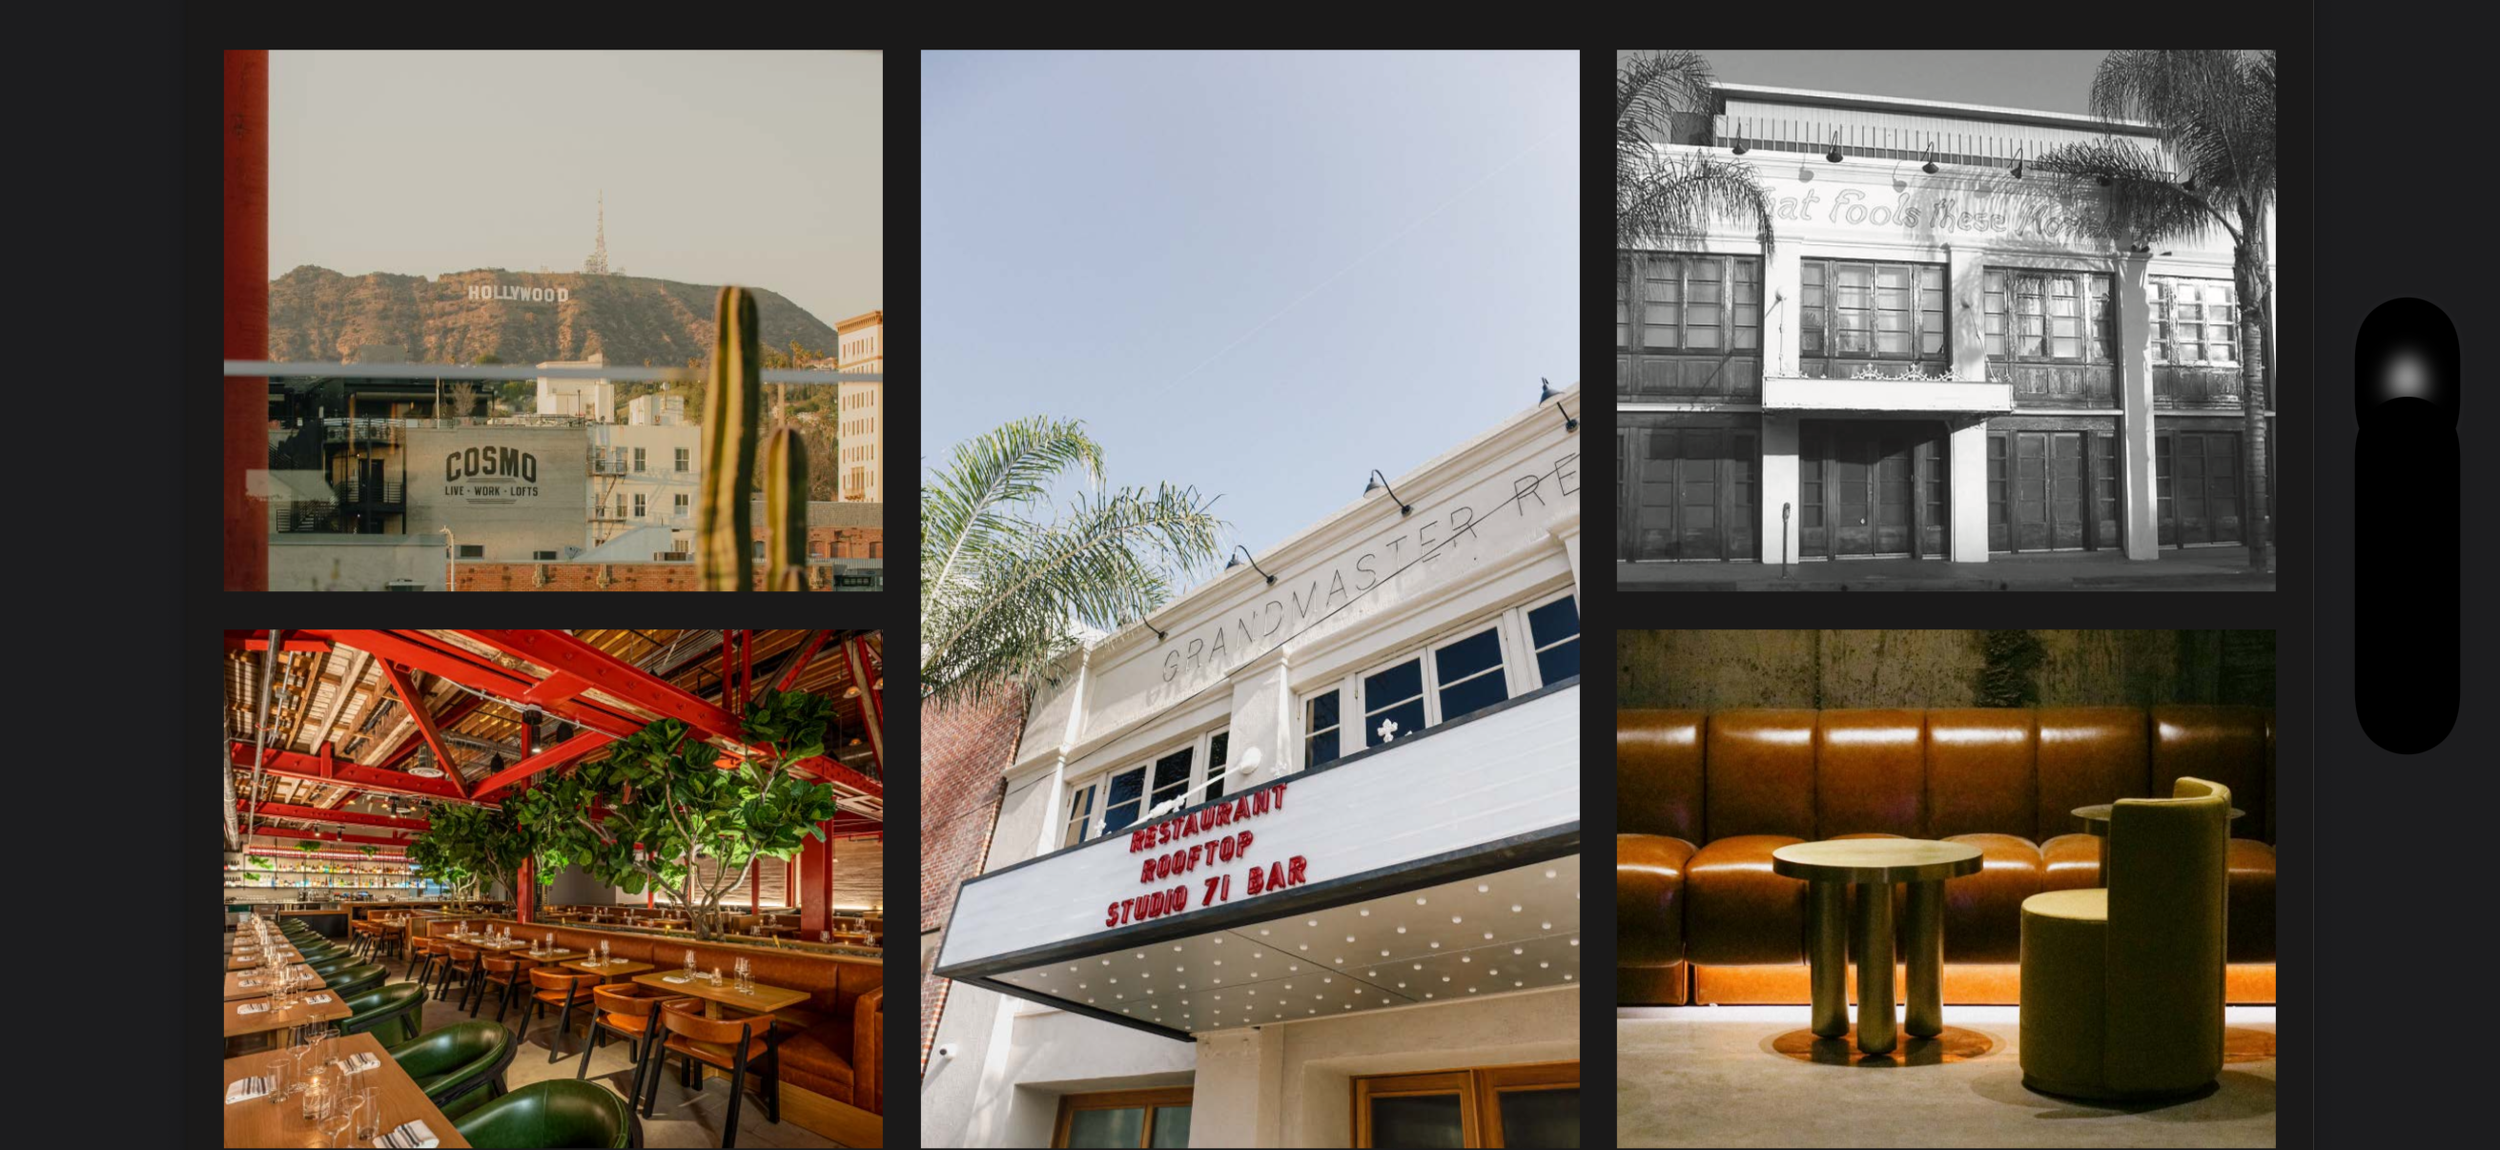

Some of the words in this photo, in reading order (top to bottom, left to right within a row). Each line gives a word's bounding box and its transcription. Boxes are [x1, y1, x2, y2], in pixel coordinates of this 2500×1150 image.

[468, 285, 569, 303] HOLLYWOOD
[445, 486, 464, 496] LIVE
[474, 486, 500, 496] WORK
[511, 486, 538, 497] LOFTS
[446, 446, 537, 483] COSMO
[1162, 506, 1478, 683] GRANDMASTER
[1129, 783, 1288, 853] RESTAURANT
[1140, 830, 1254, 884] ROOFTOP
[1105, 885, 1189, 928] STUDIO
[1247, 855, 1308, 895] BAR
